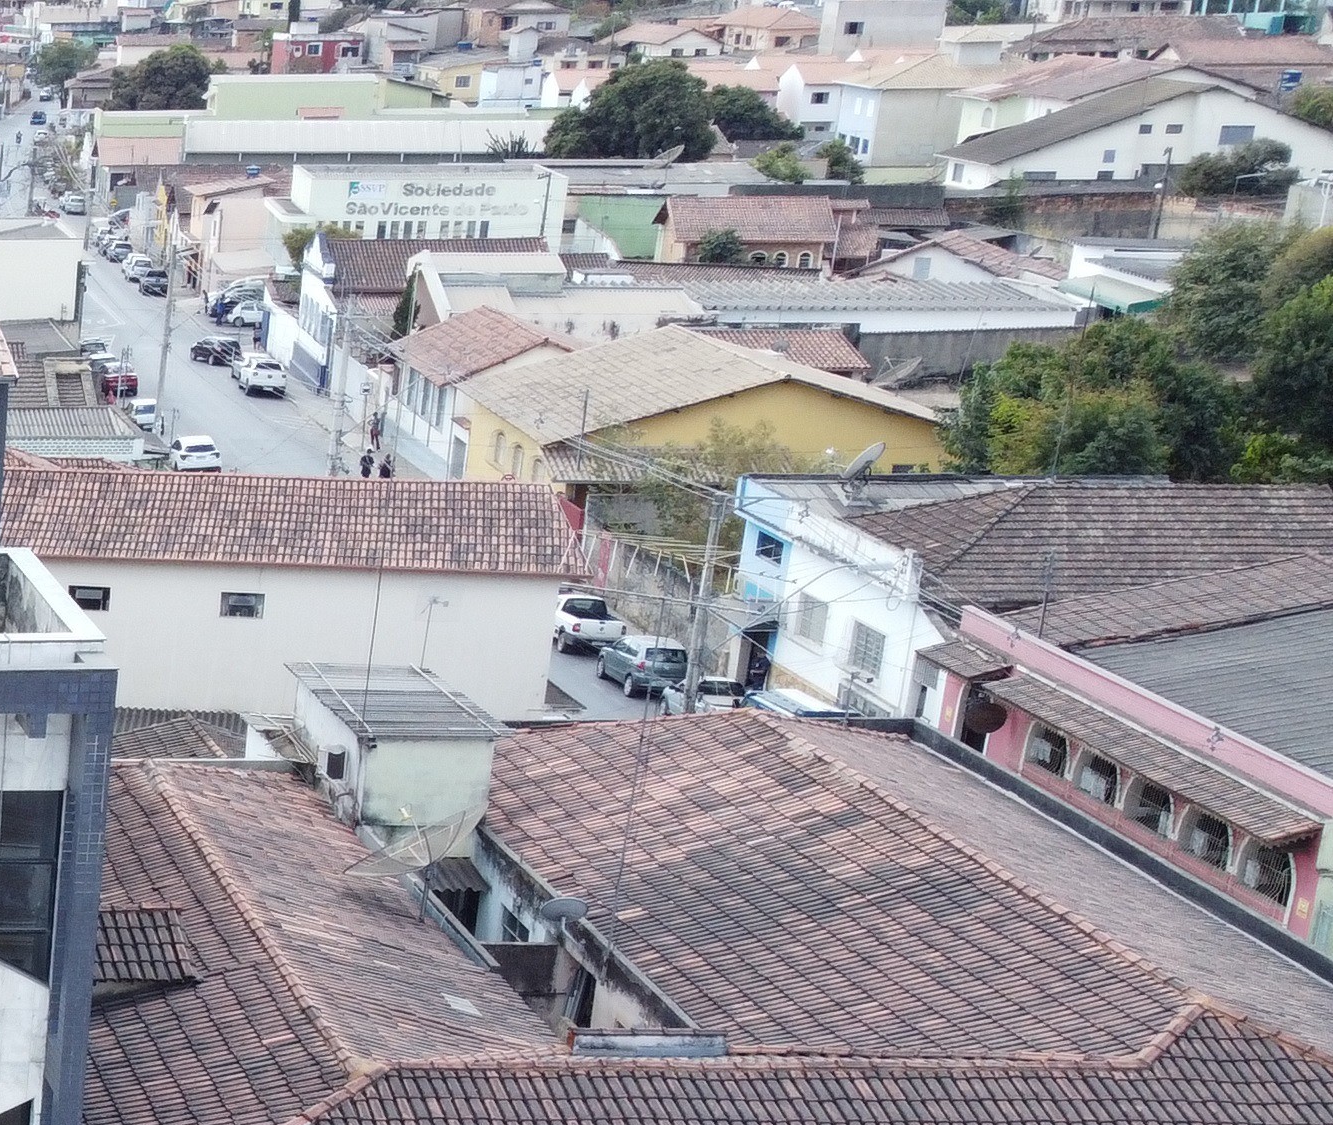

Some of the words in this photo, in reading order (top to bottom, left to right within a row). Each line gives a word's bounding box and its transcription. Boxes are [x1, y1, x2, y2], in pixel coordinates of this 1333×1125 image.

[402, 183, 497, 197] Sociedade
[345, 202, 379, 216] São
[381, 202, 449, 216] Vicente
[454, 203, 476, 216] de
[480, 203, 529, 216] Paulo
